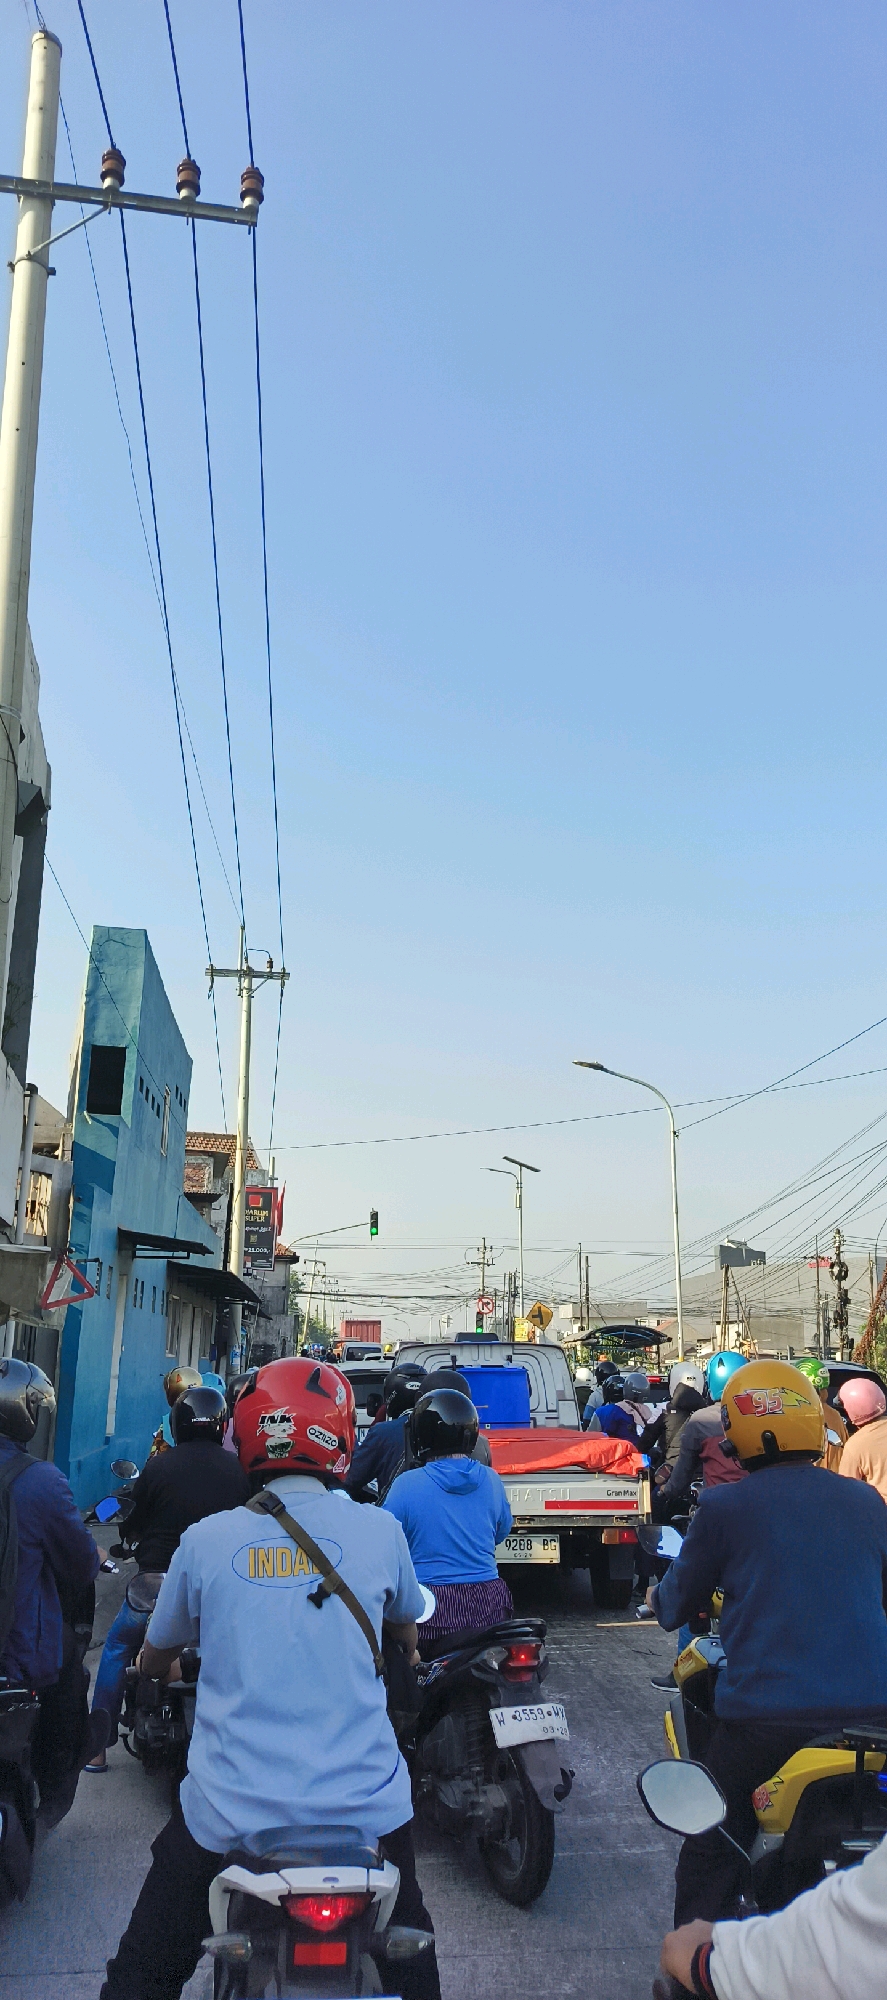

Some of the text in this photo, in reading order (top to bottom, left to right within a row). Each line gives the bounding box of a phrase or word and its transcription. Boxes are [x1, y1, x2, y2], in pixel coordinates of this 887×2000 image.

[752, 1387, 783, 1417] 95
[505, 1538, 557, 1551] 9288 BG
[495, 1712, 505, 1727] W
